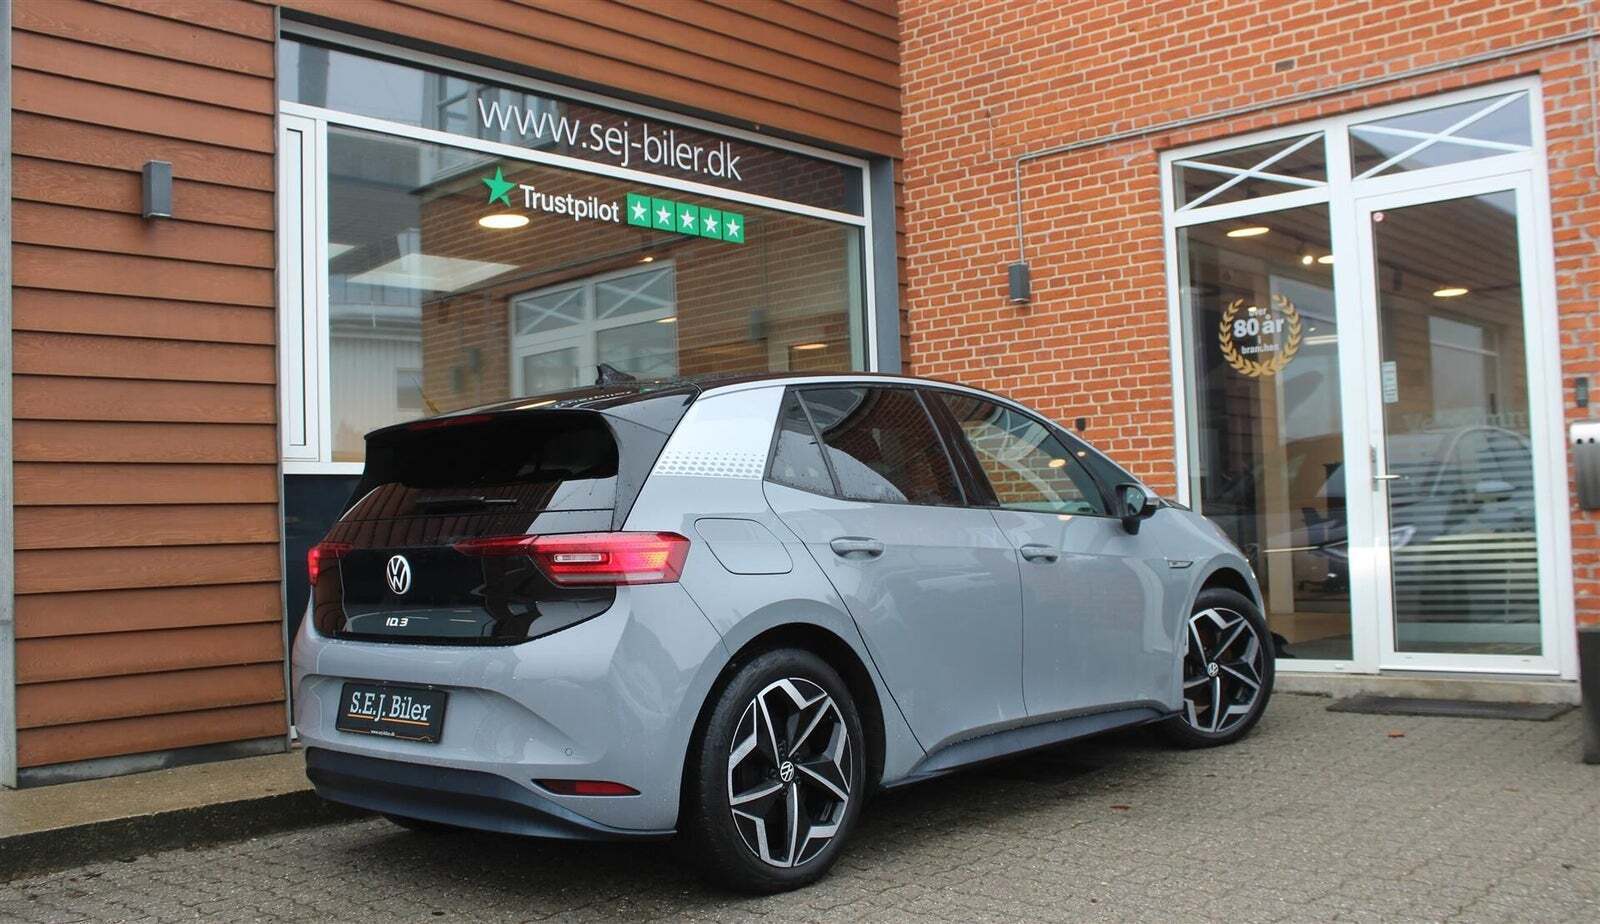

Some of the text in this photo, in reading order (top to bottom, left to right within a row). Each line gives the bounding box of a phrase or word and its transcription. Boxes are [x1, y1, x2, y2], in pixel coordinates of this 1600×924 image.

[478, 98, 742, 181] www.sej-biler.dk
[519, 184, 620, 223] Trustpilot
[1233, 314, 1284, 338] 80 år
[350, 691, 431, 721] S.E.J. Biler
